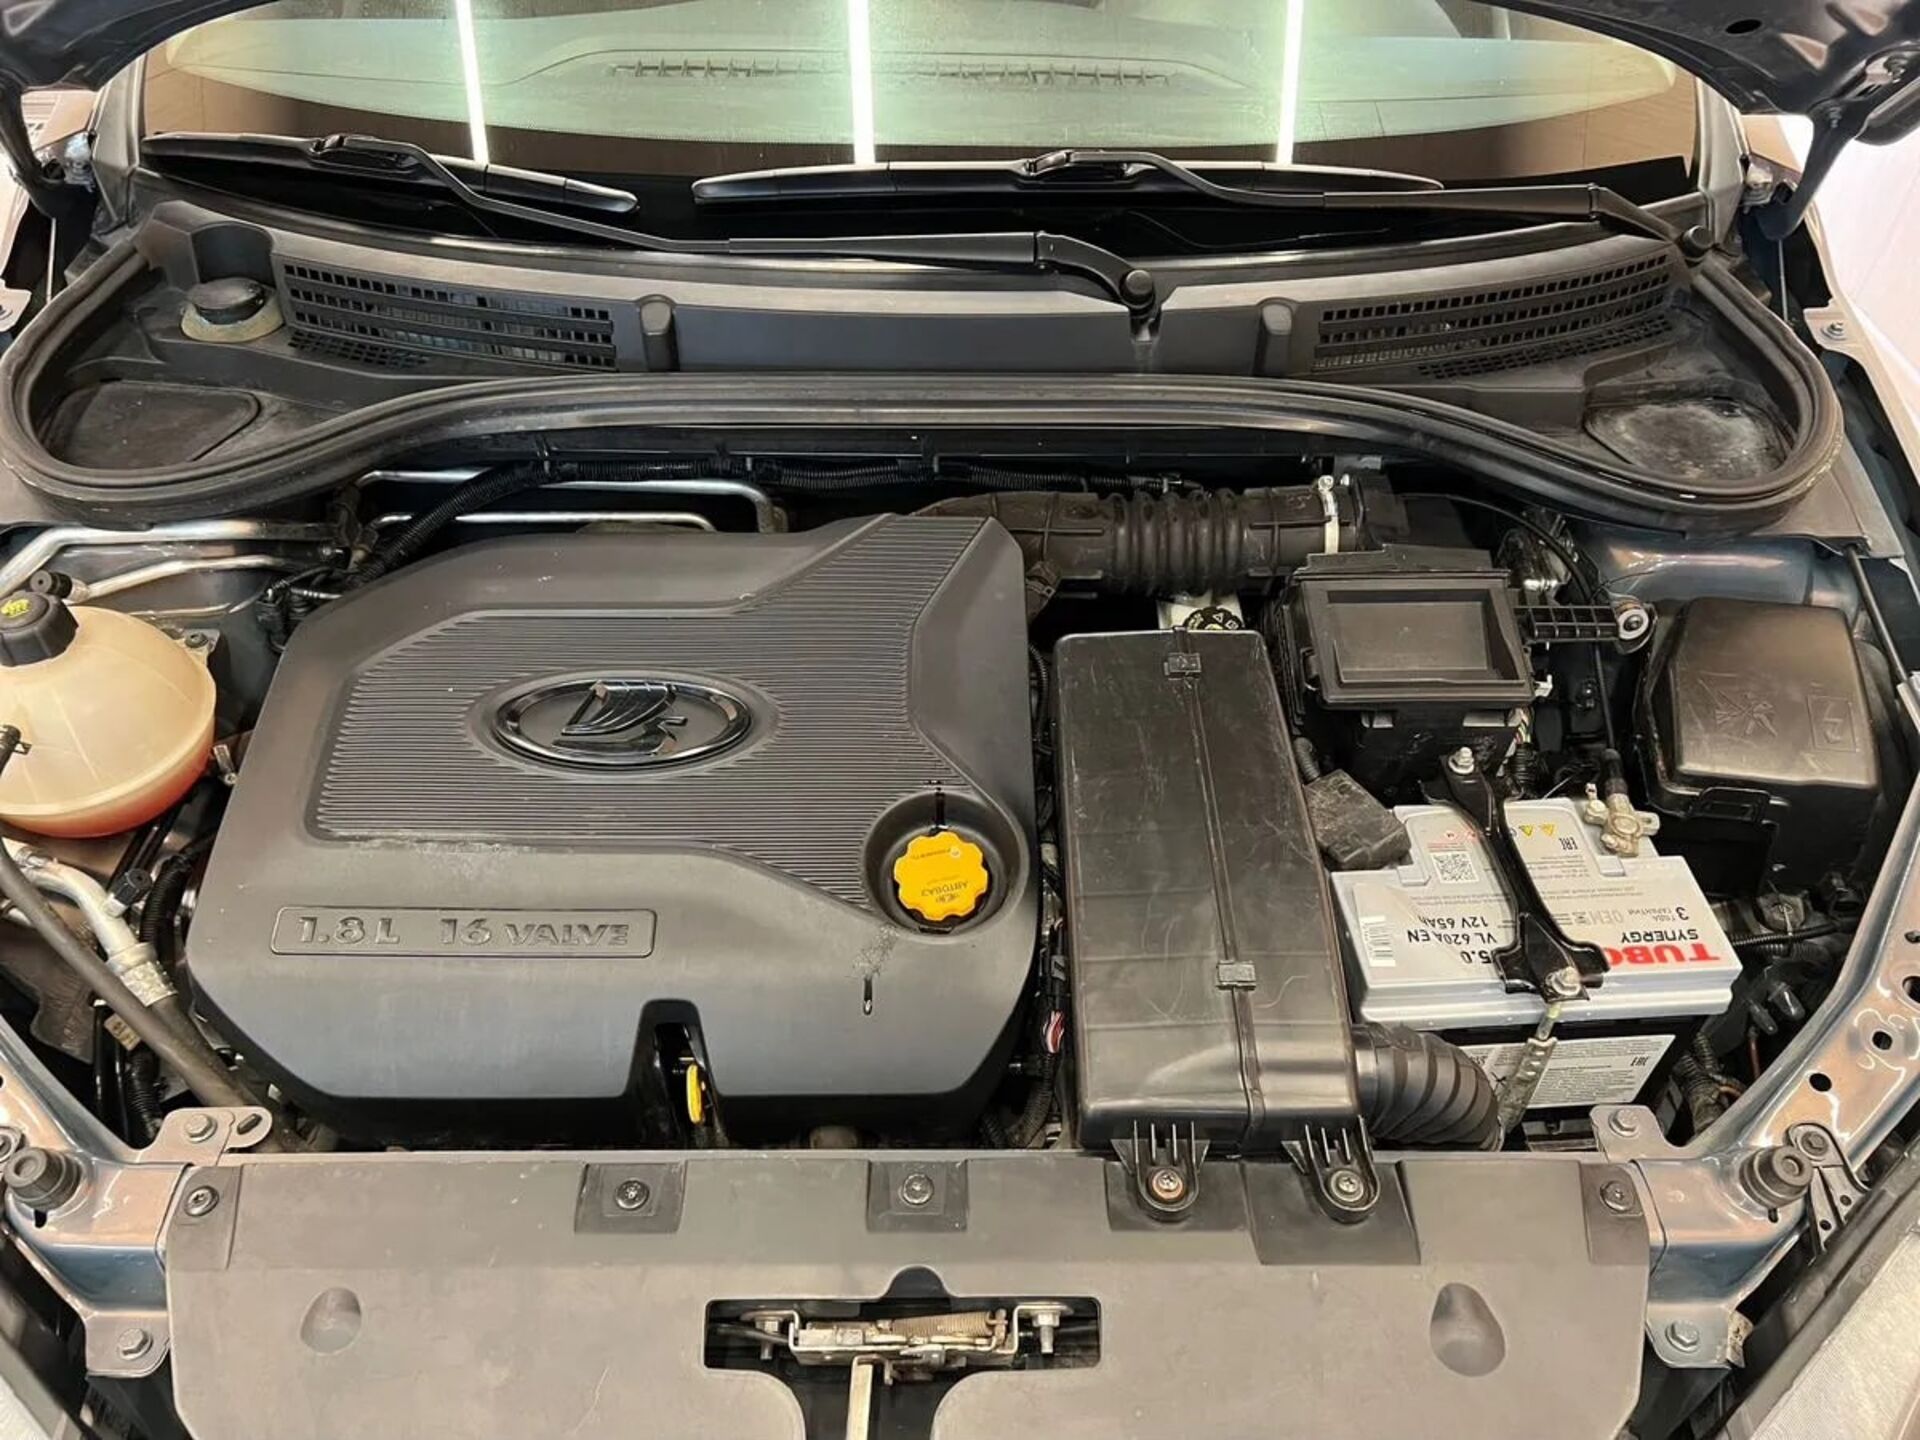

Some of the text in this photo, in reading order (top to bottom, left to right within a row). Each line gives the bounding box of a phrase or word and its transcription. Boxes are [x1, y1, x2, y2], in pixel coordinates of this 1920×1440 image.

[1675, 906, 1690, 921] 3
[1461, 916, 1489, 929] 12V
[439, 916, 492, 946] 16
[503, 922, 631, 946] VALVE
[1406, 930, 1431, 944] EN
[1474, 932, 1497, 944] VL
[1620, 929, 1700, 944] SYNERGY
